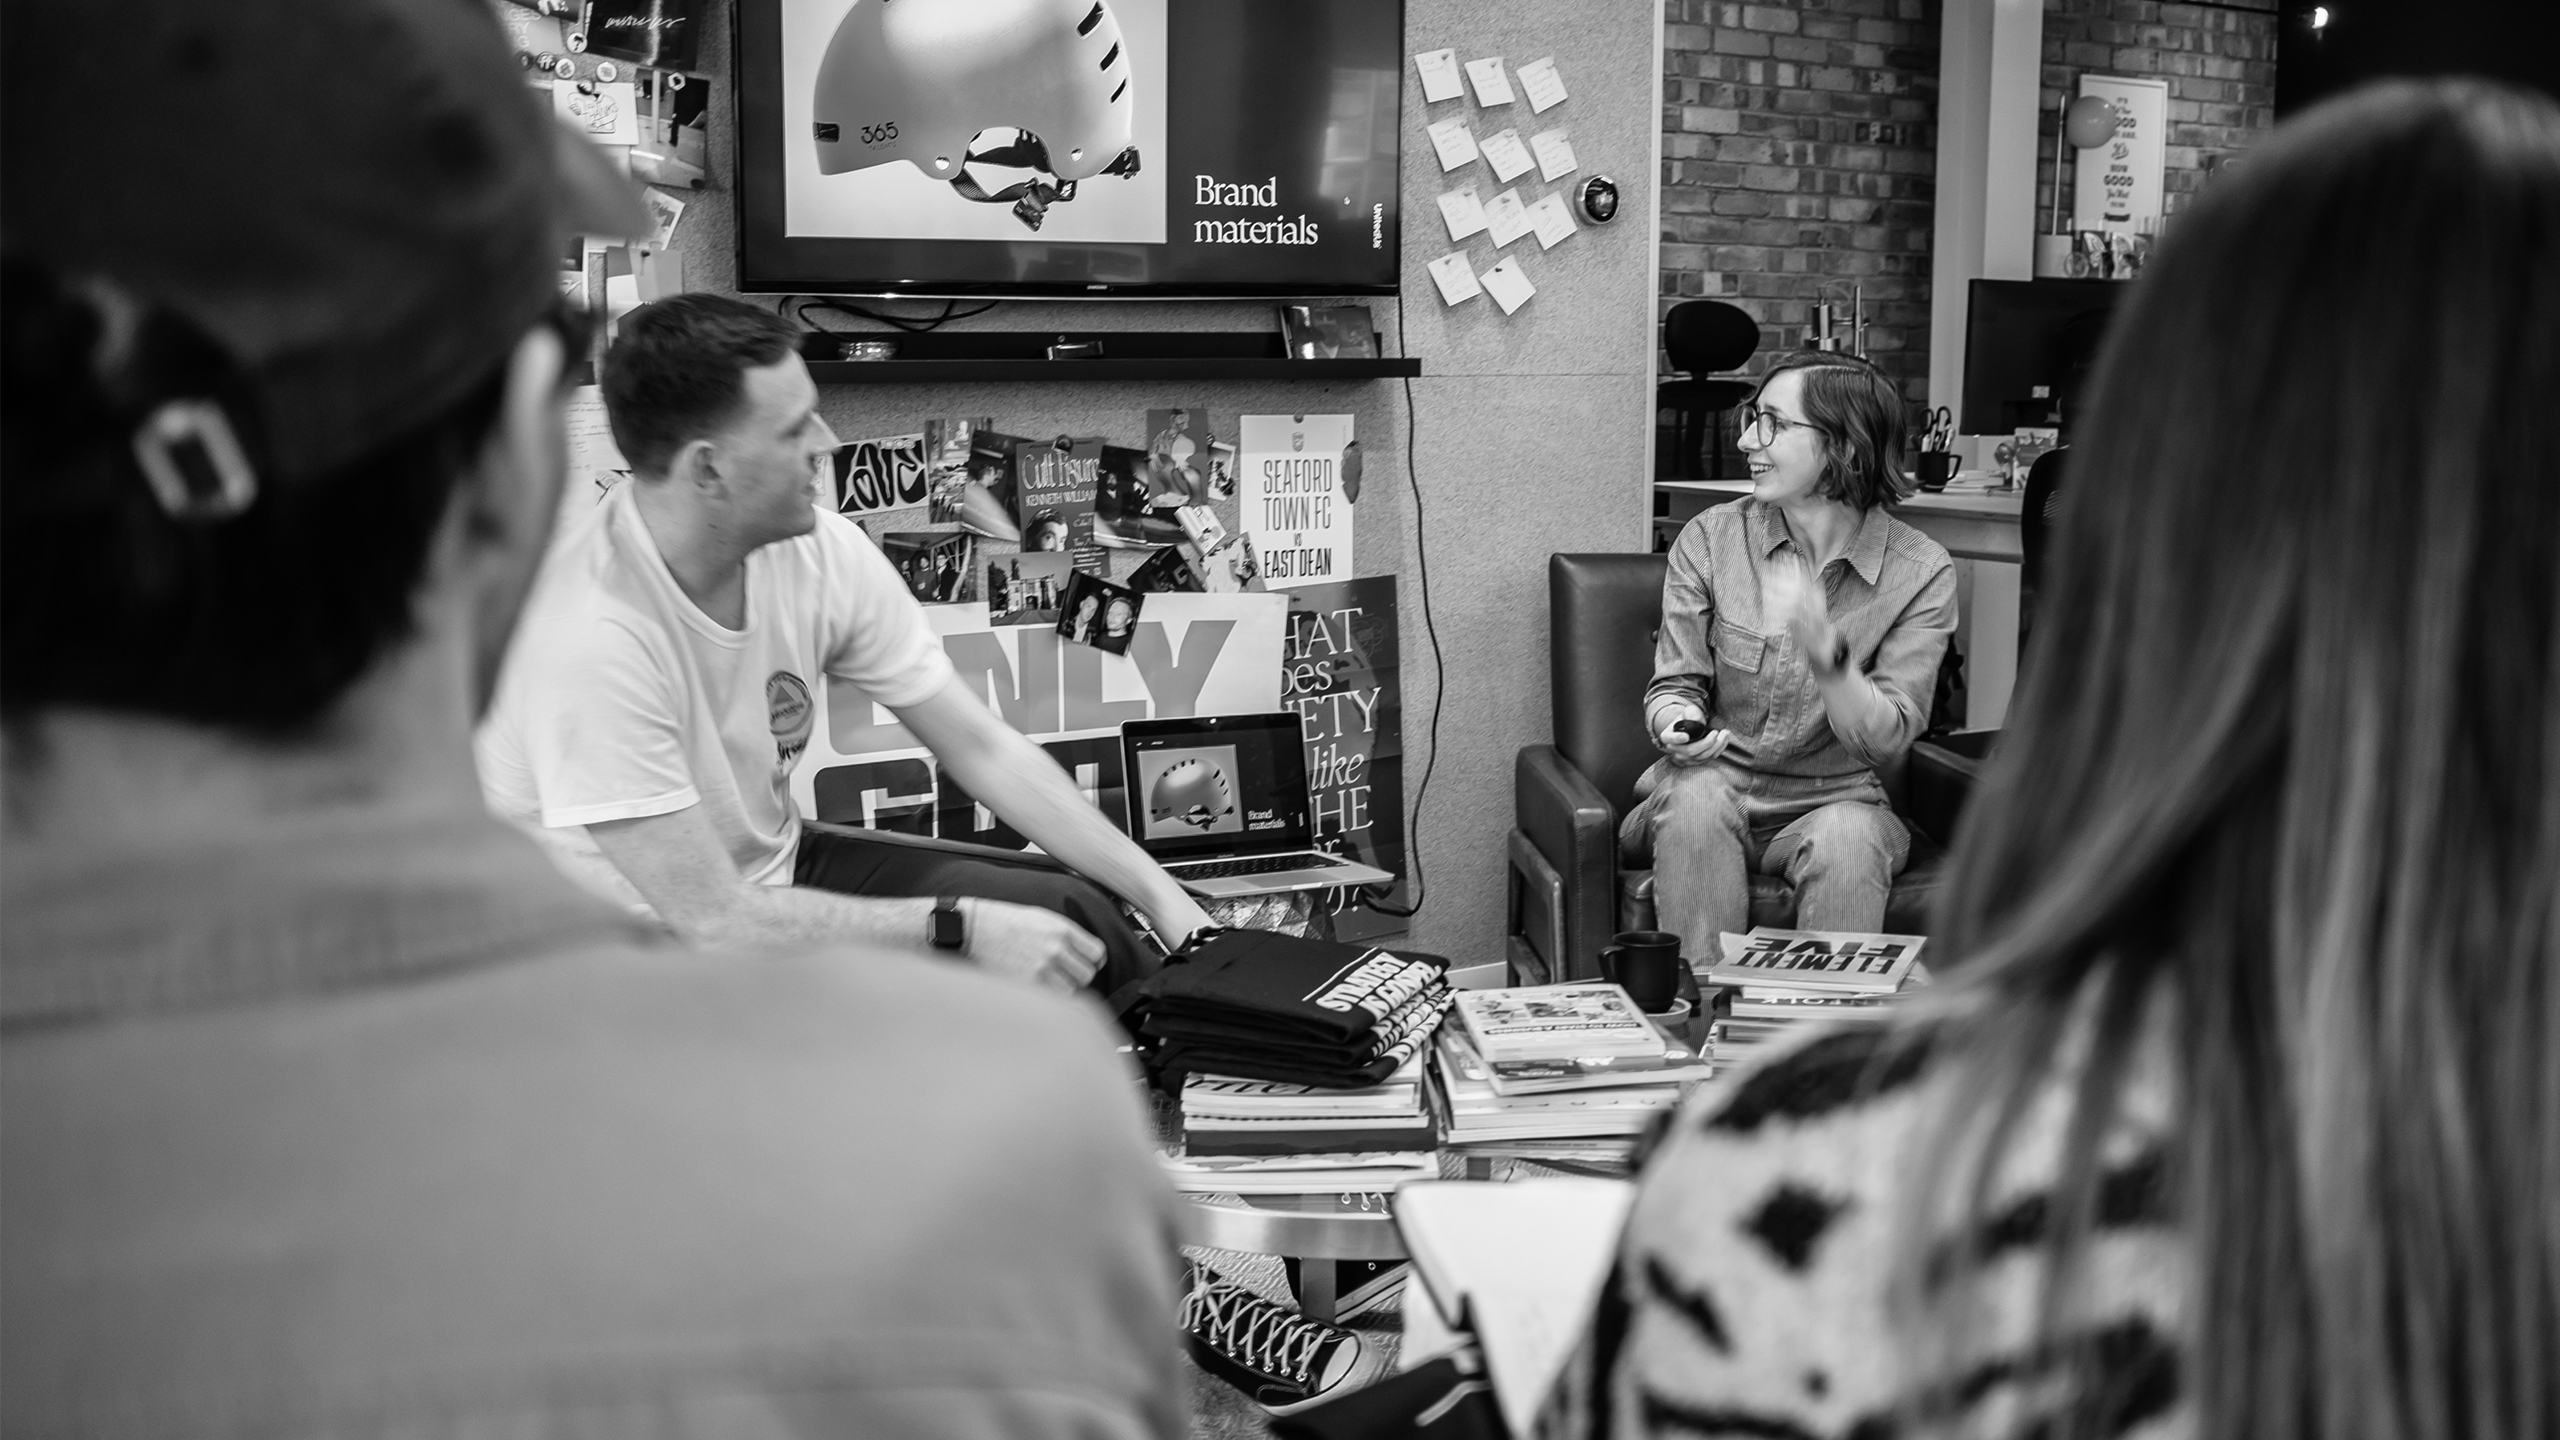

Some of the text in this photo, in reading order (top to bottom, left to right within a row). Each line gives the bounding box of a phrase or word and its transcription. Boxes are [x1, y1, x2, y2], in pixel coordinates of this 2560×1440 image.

[861, 121, 898, 144] 365
[1194, 175, 1277, 207] Brand
[2103, 175, 2134, 186] GOOD
[1194, 214, 1318, 245] materials
[1263, 458, 1333, 495] SEAFORD
[1262, 496, 1332, 532] TOWN FC
[1264, 548, 1332, 579] EAST DEAN
[1283, 607, 1364, 661] HAT
[1281, 660, 1333, 697] oes
[1311, 743, 1366, 792] like
[1247, 809, 1273, 820] Brand
[1310, 785, 1374, 838] HE
[1729, 951, 1896, 975] ELEMENT
[1744, 936, 1907, 959] FIVE
